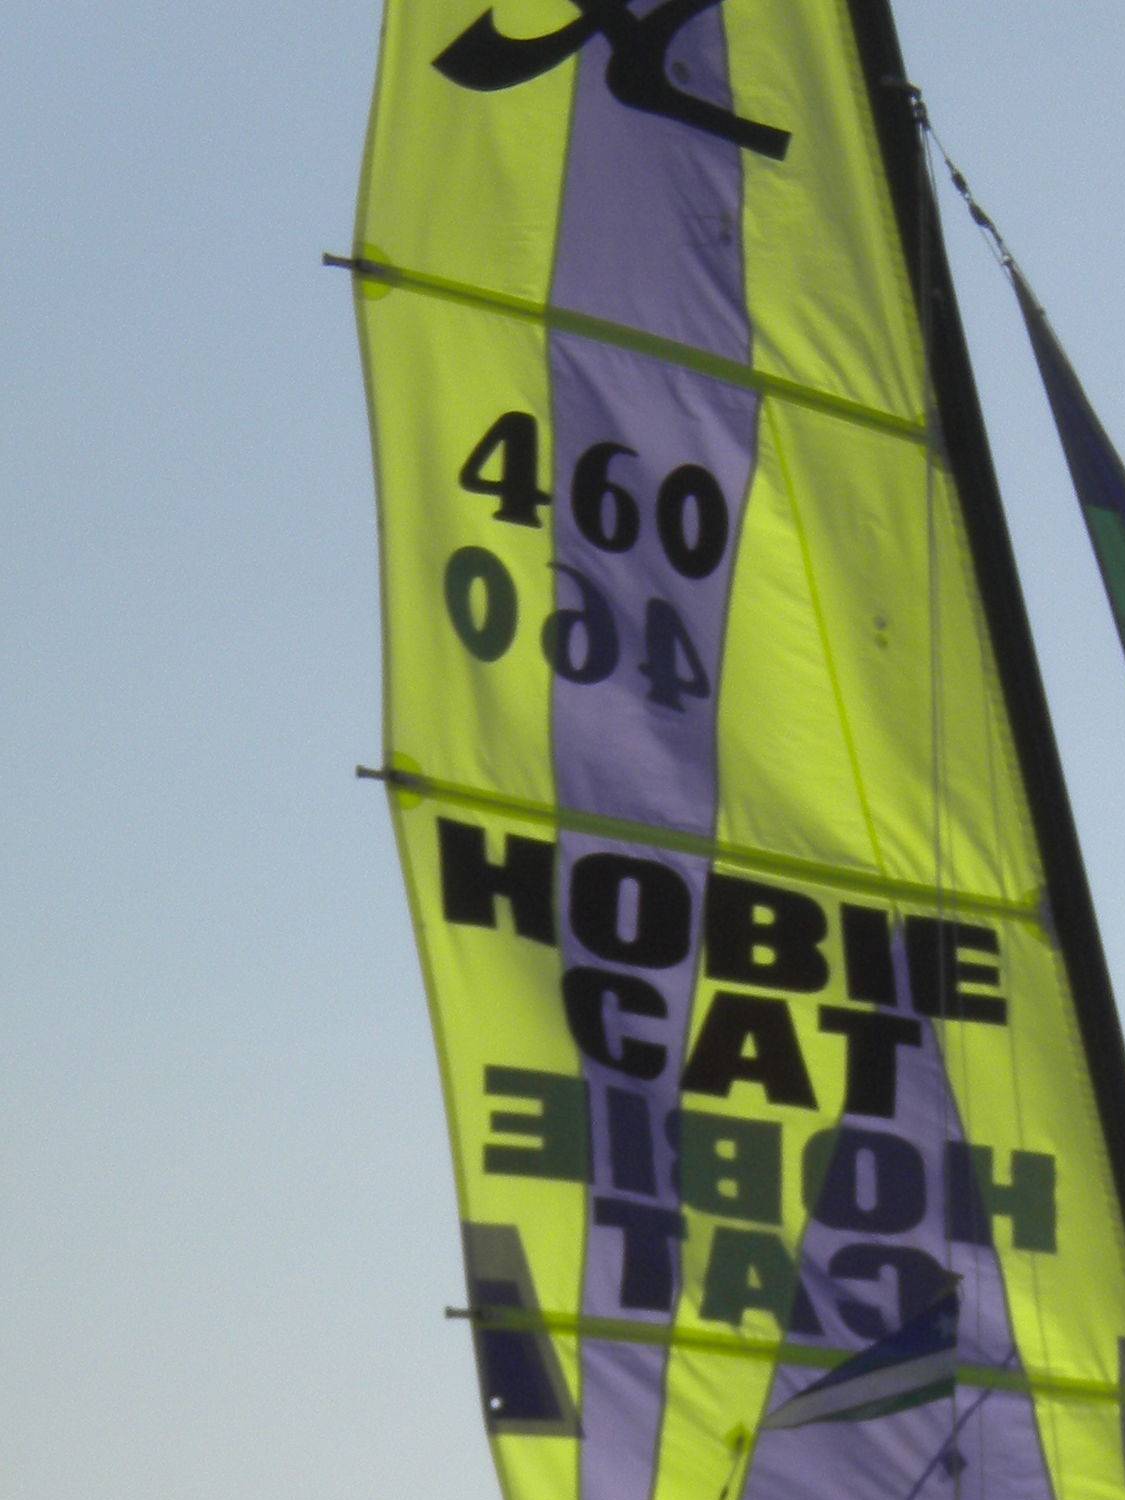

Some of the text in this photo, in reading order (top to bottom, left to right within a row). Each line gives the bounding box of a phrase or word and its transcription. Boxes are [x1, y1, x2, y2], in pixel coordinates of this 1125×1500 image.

[458, 410, 729, 580] 460
[436, 815, 1008, 1027] HOBIE
[560, 966, 923, 1120] CAT
